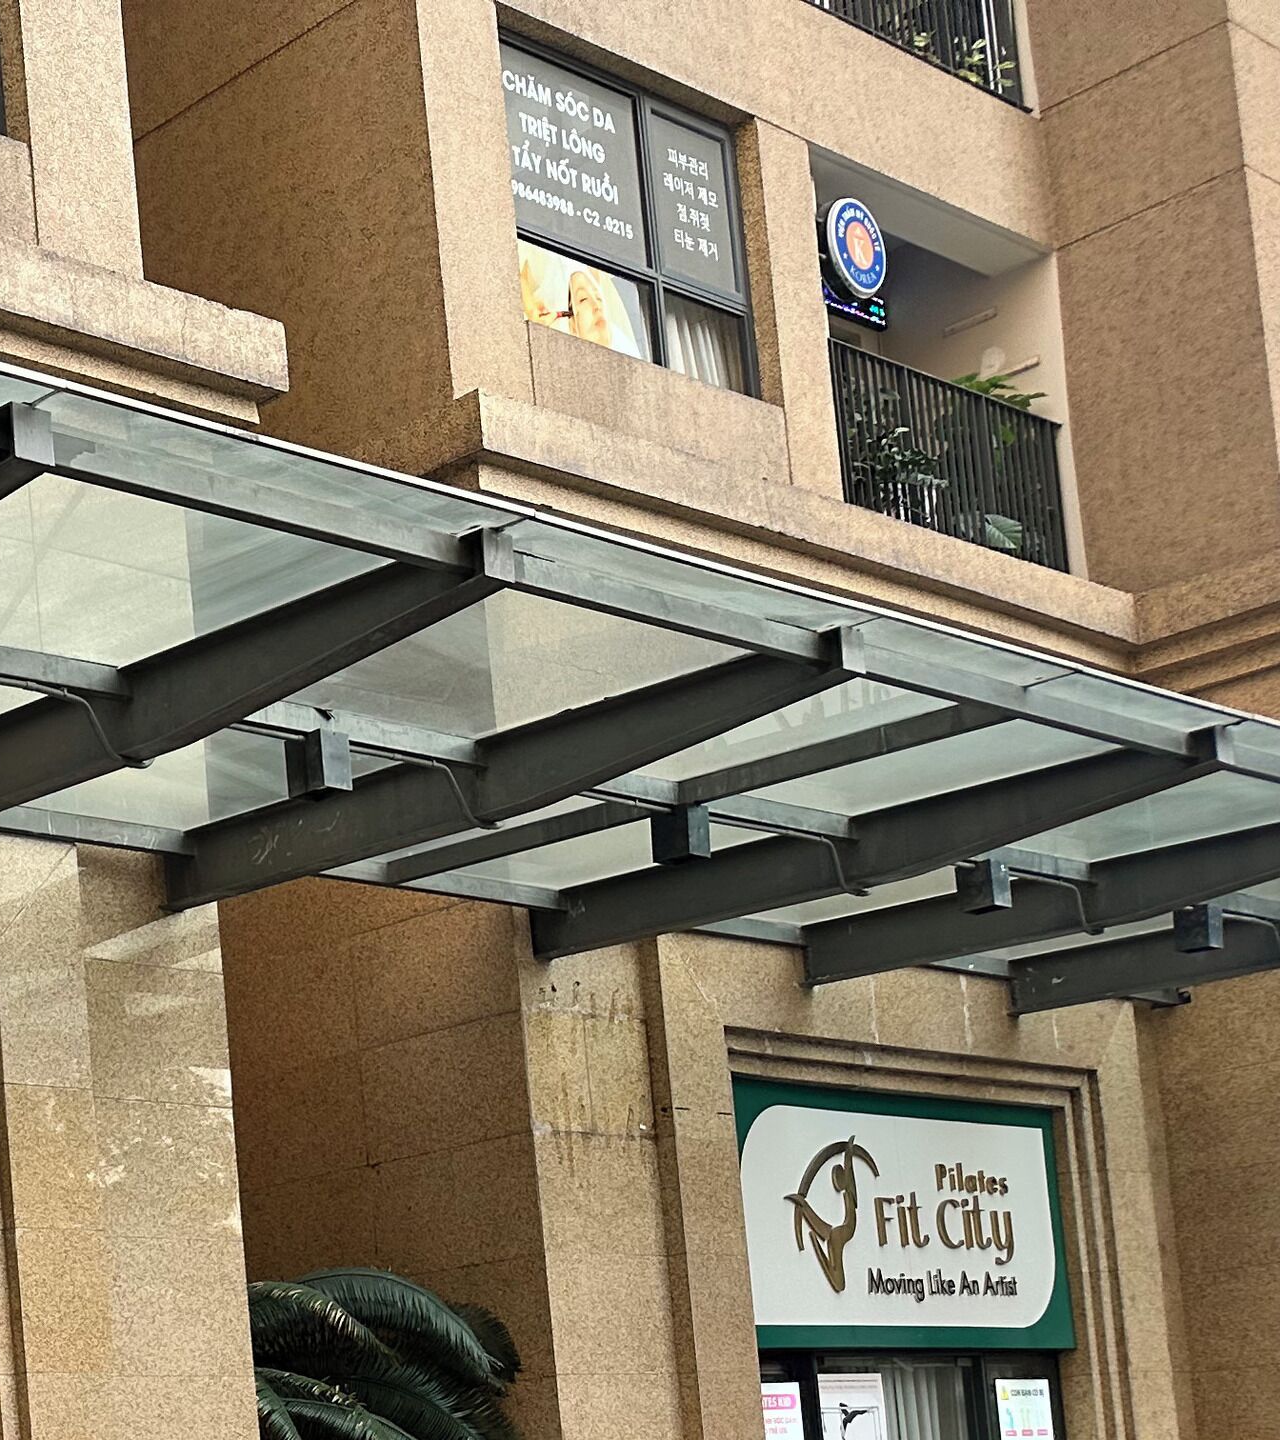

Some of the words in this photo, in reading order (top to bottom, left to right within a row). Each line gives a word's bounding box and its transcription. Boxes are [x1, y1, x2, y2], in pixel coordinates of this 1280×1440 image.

[502, 70, 552, 107] CHĂM
[555, 91, 589, 122] SÓC
[593, 107, 616, 134] DA
[519, 112, 557, 147] TRIỆT
[561, 128, 606, 163] LÔNG
[546, 158, 578, 189] NỐT
[934, 1163, 1009, 1195] Pilates
[874, 1191, 930, 1248] Fit
[936, 1195, 1014, 1265] City
[867, 1267, 926, 1303] Moving
[926, 1269, 956, 1296] Like
[959, 1271, 980, 1296] An
[983, 1271, 1018, 1297] Artist
